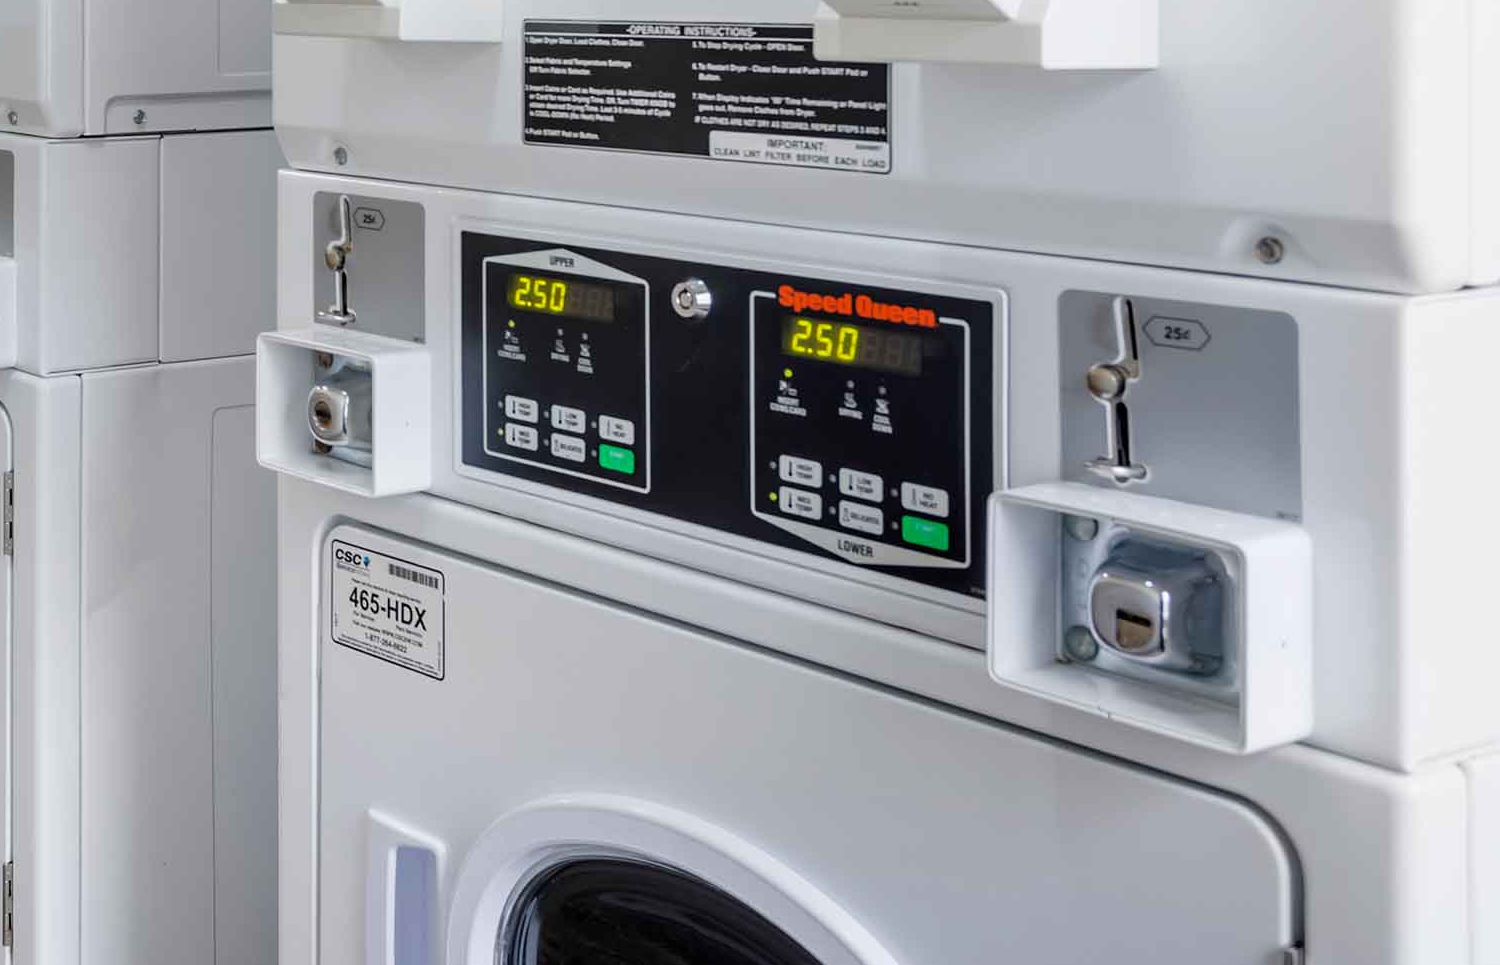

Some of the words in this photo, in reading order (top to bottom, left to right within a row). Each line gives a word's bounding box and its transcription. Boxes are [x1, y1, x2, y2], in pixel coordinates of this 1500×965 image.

[714, 147, 740, 157] CLEAN
[743, 149, 761, 158] LINT
[765, 150, 792, 161] FILTER
[796, 153, 830, 164] BEFORE
[834, 156, 858, 167] EACH
[862, 158, 887, 169] LOAD
[548, 255, 575, 268] UPPER
[514, 276, 567, 313] 2.50
[778, 284, 853, 316] Speed
[854, 294, 937, 329] Queen
[791, 319, 859, 362] 2.50
[919, 500, 938, 510] HEAT
[922, 492, 934, 500] NO
[335, 548, 363, 566] CSC
[836, 538, 874, 558] LOWER
[349, 587, 428, 632] 465-HDX
